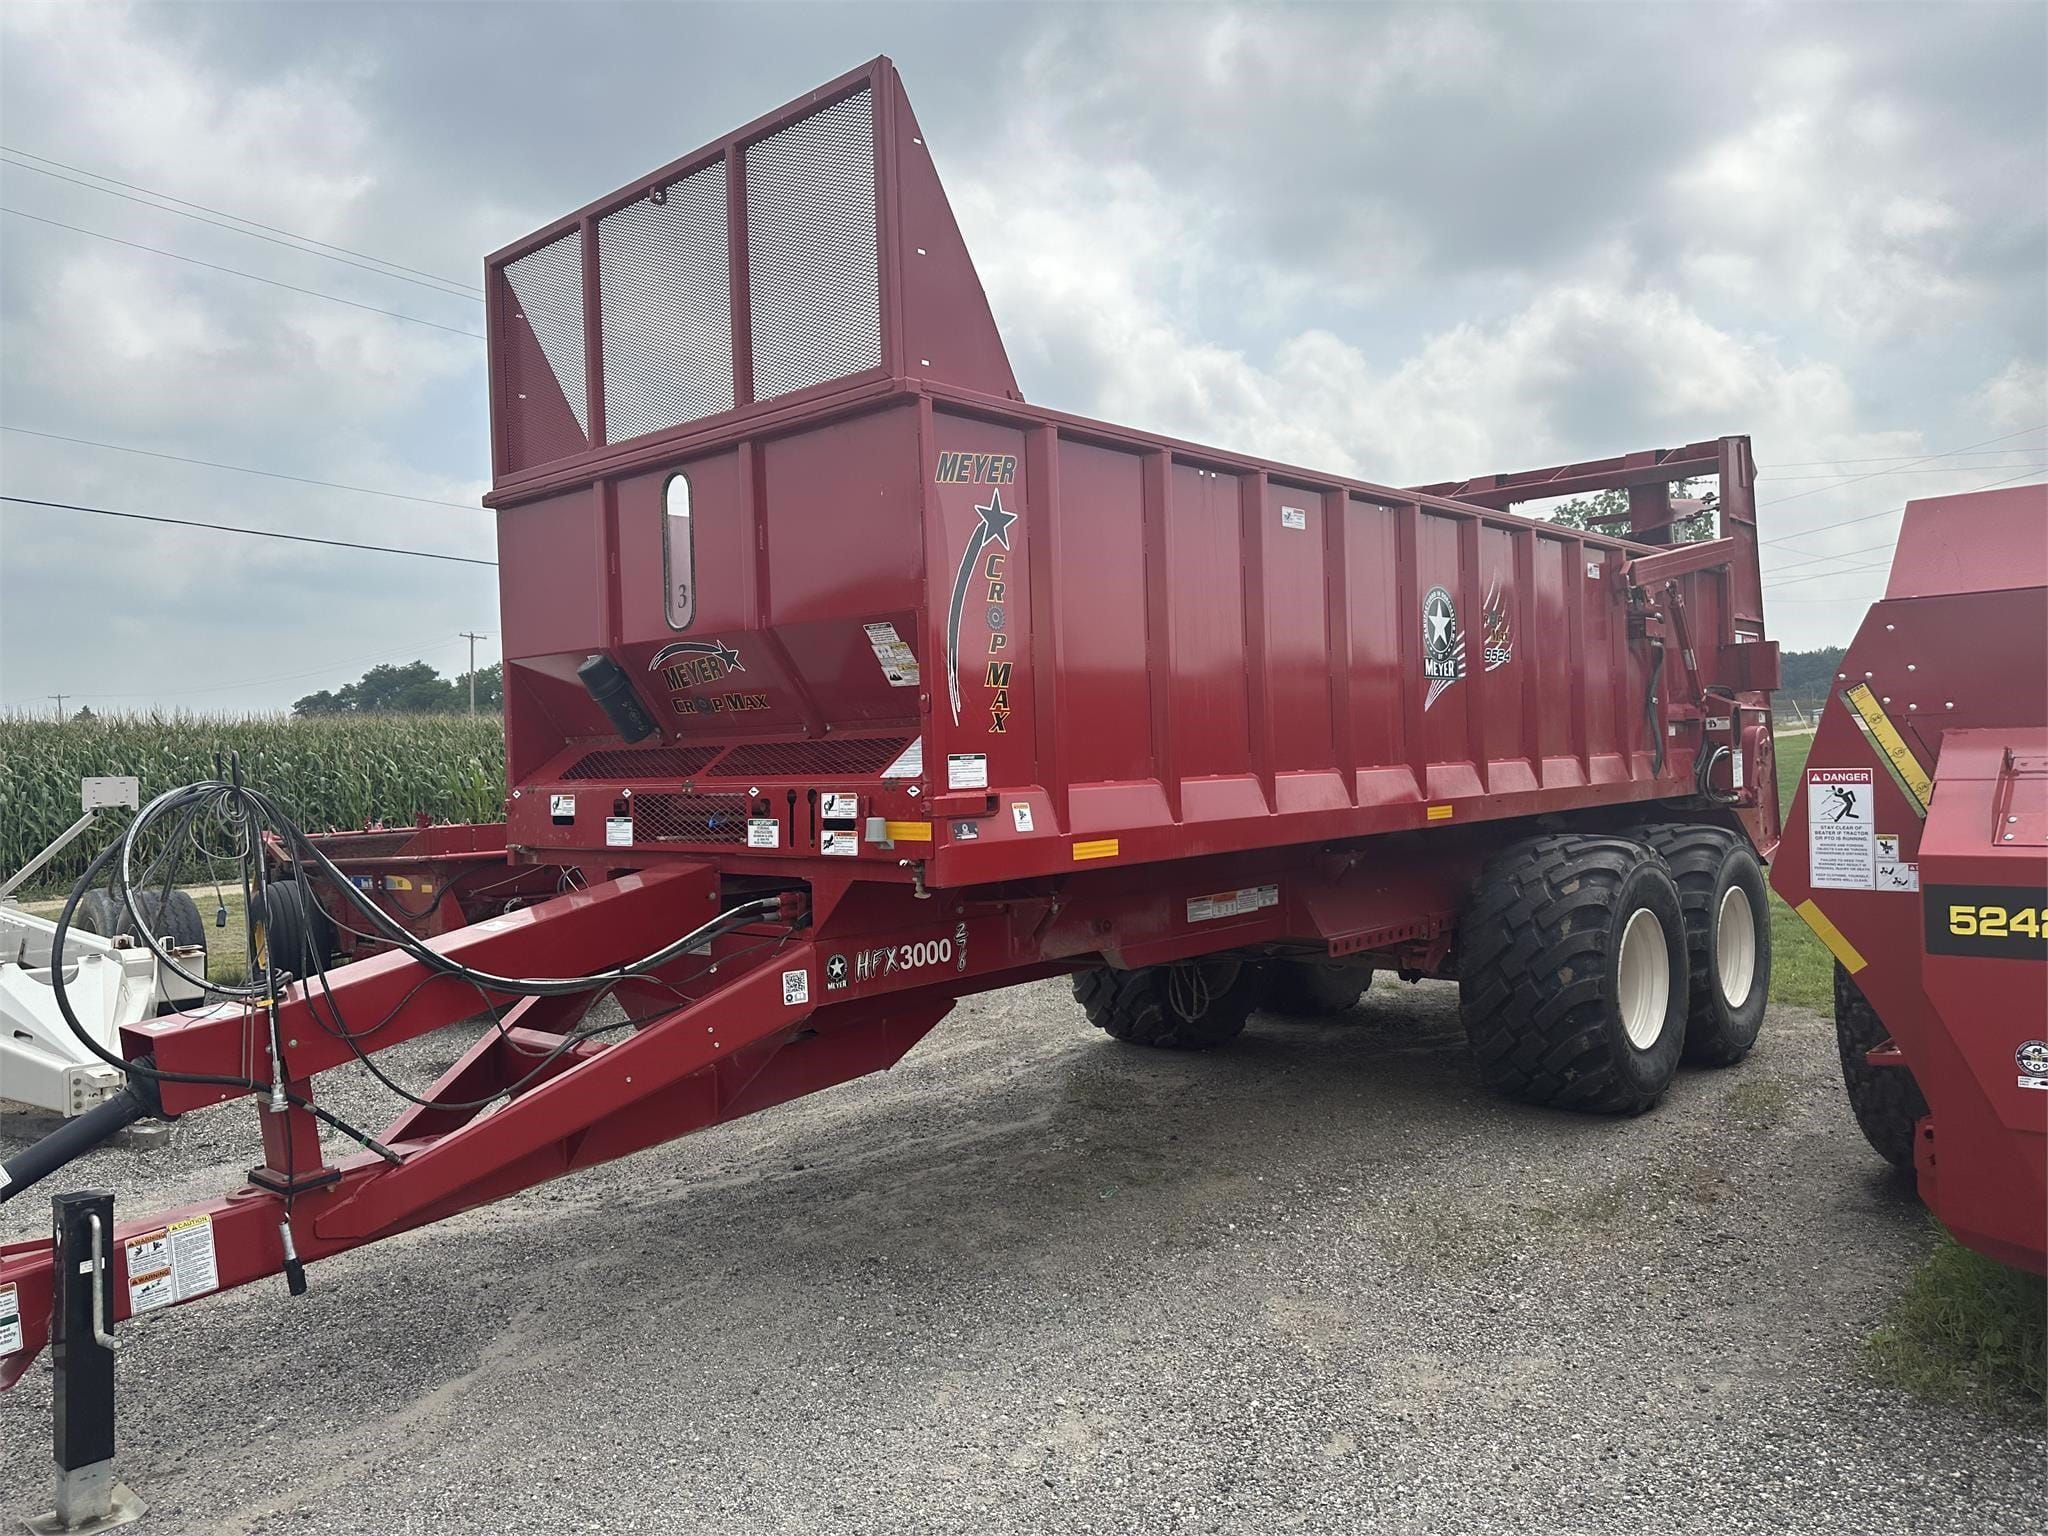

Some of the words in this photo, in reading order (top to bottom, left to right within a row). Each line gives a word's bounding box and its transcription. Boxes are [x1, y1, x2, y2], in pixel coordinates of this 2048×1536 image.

[936, 452, 1017, 484] MEYER
[677, 584, 687, 608] 3
[1484, 648, 1511, 663] 9524
[662, 656, 724, 692] MEYER
[1424, 659, 1456, 677] MEYER
[723, 693, 771, 712] MAX
[984, 661, 1014, 733] MAX
[1823, 773, 1869, 781] DANGER
[1950, 906, 2048, 938] 524
[827, 980, 848, 990] MEYER
[178, 1216, 207, 1228] CAUTION
[134, 1230, 167, 1245] WARNING
[138, 1270, 170, 1282] WARNING
